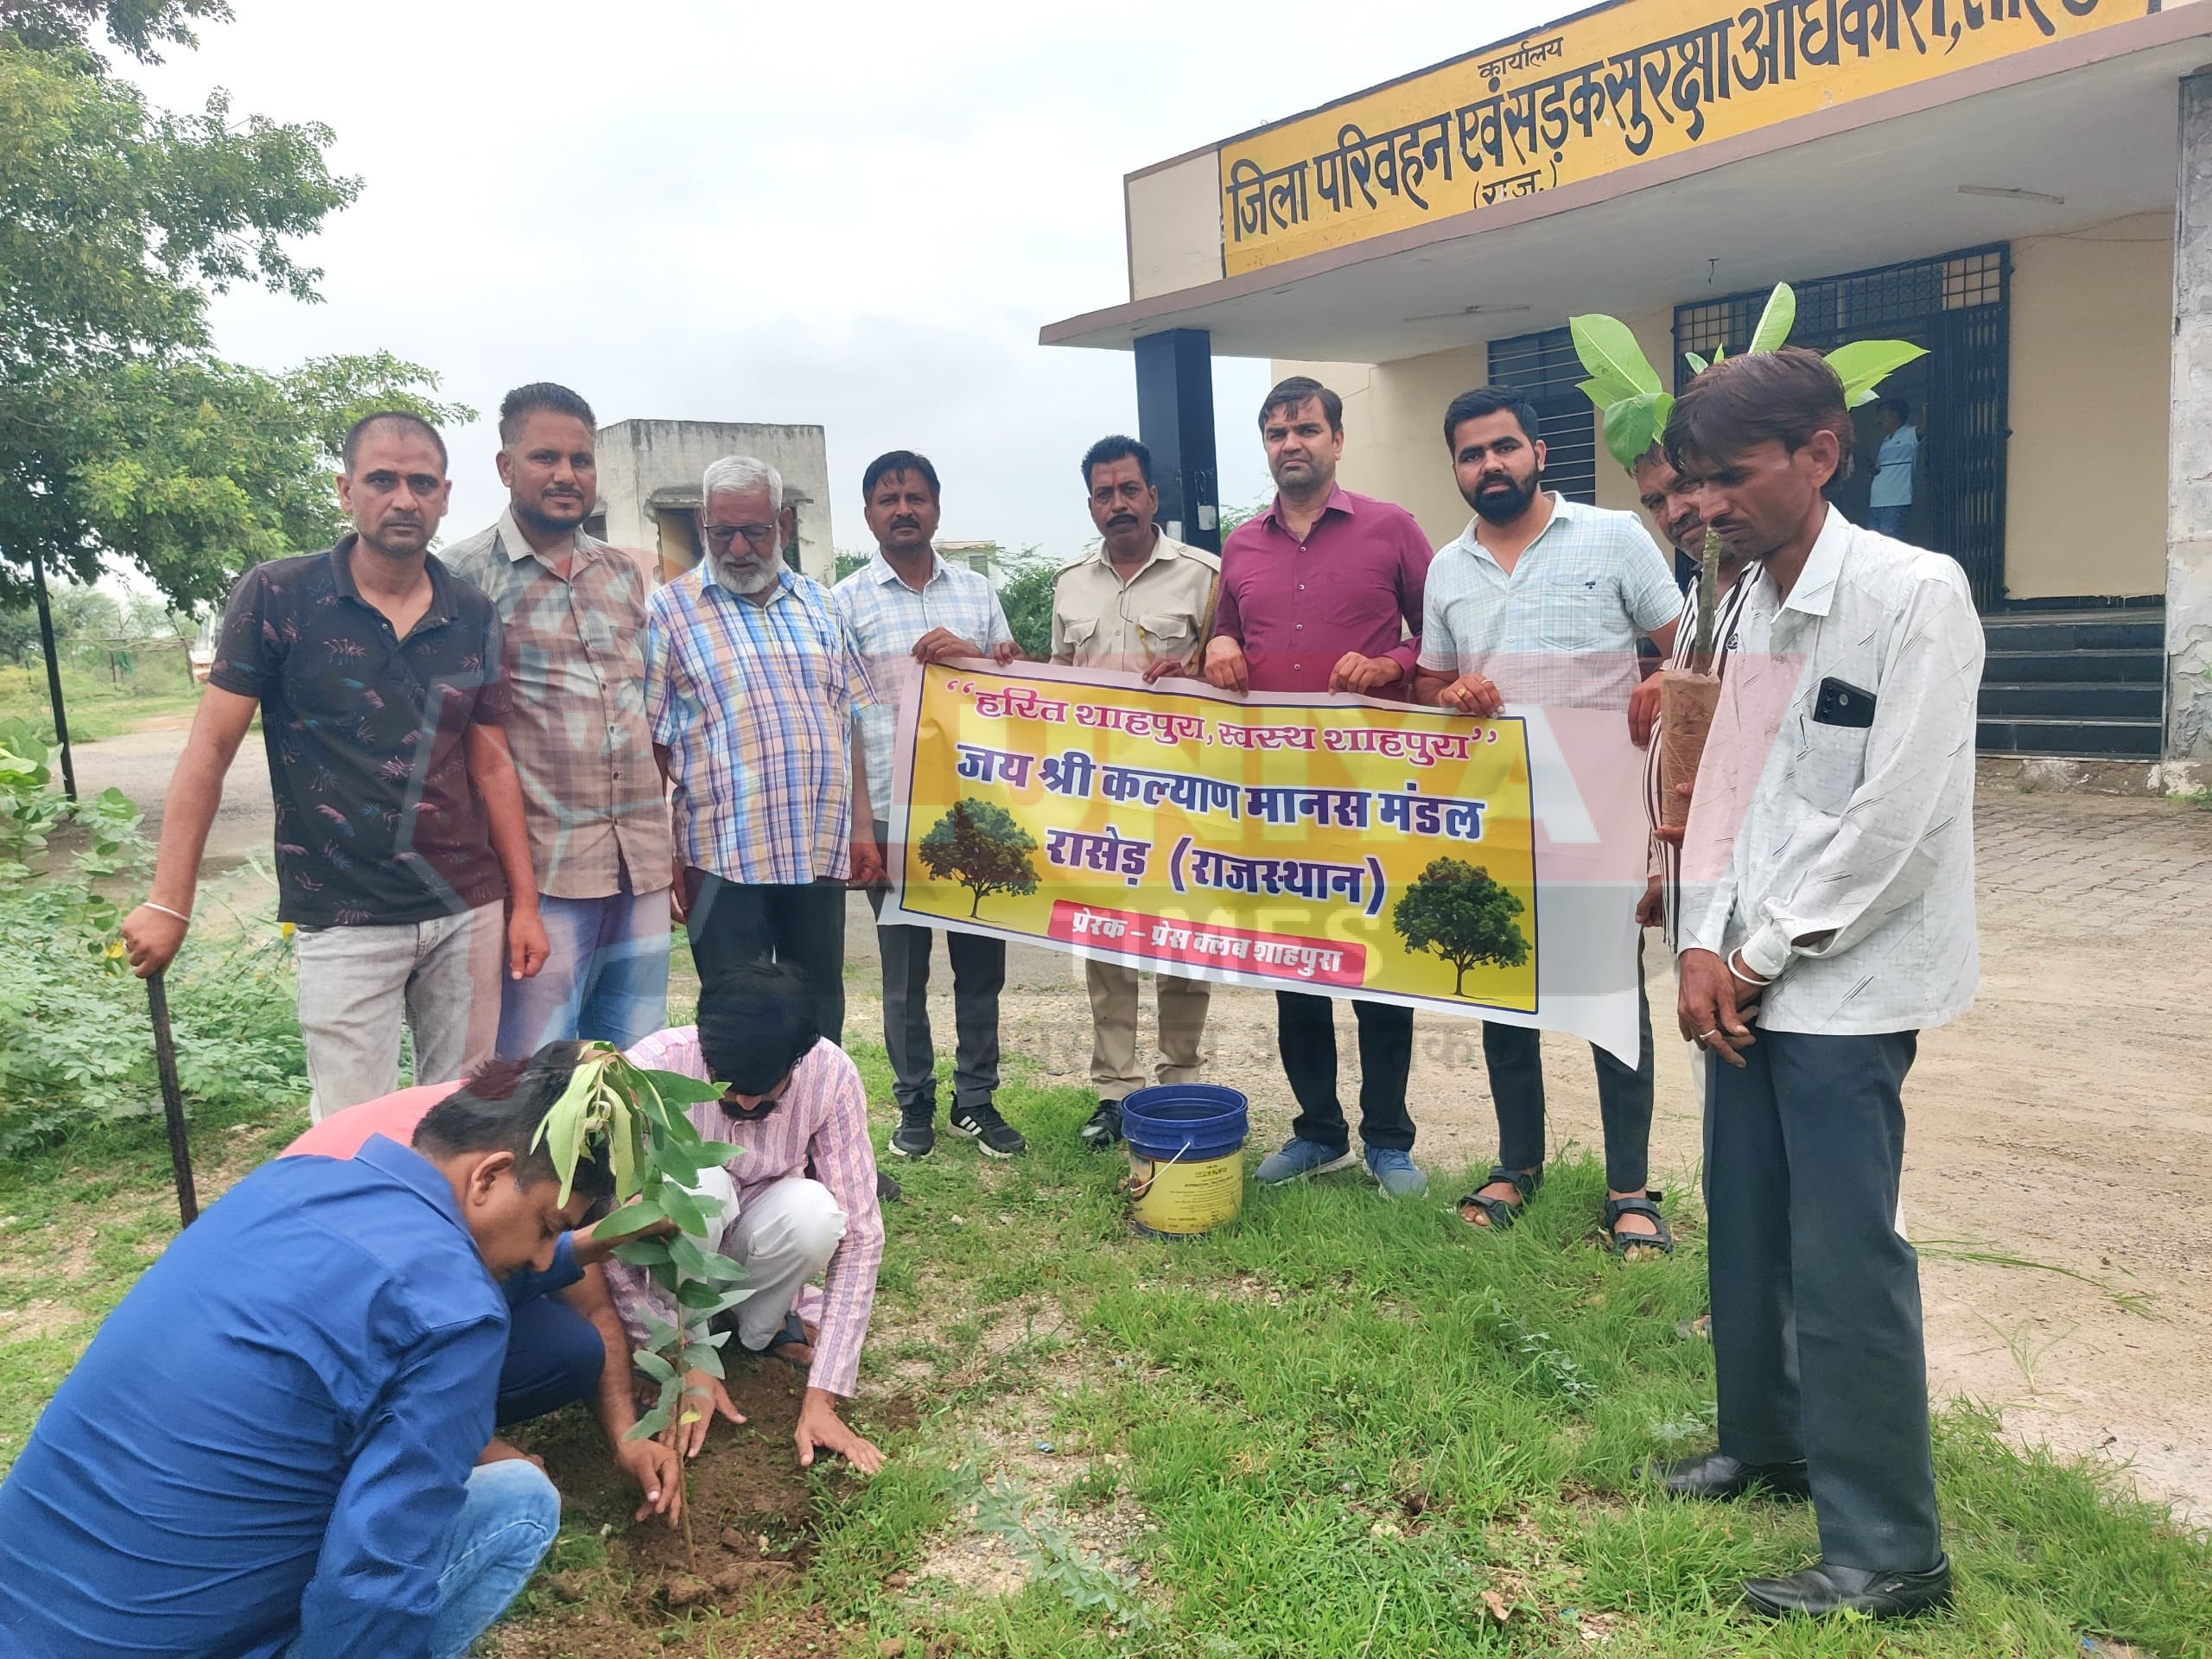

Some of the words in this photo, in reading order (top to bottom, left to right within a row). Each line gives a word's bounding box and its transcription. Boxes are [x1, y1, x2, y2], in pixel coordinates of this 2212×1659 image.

[1477, 36, 1565, 79] कार्यालय
[1225, 158, 1308, 243] जिला
[1313, 124, 1452, 211] परिवहन
[1455, 76, 1505, 172] एवं
[1503, 60, 1607, 164] सड़क
[1604, 17, 1735, 156] सुरक्षा
[1075, 704, 1213, 745] शाहपुरा,
[1218, 722, 1315, 751] स्वस्थ
[957, 744, 1034, 788] जय
[1038, 751, 1096, 798] श्री
[1103, 766, 1240, 819] कल्याण
[1245, 787, 1371, 827] मानस
[1378, 782, 1485, 840] मंडल
[1046, 825, 1151, 886] रासेड़
[1171, 837, 1385, 916] (राजस्थान)
[1072, 907, 1128, 939] प्रेरक
[1150, 921, 1192, 951] प्रेस
[1193, 931, 1251, 960] क्लब
[1253, 942, 1343, 977] शाहपुरा
